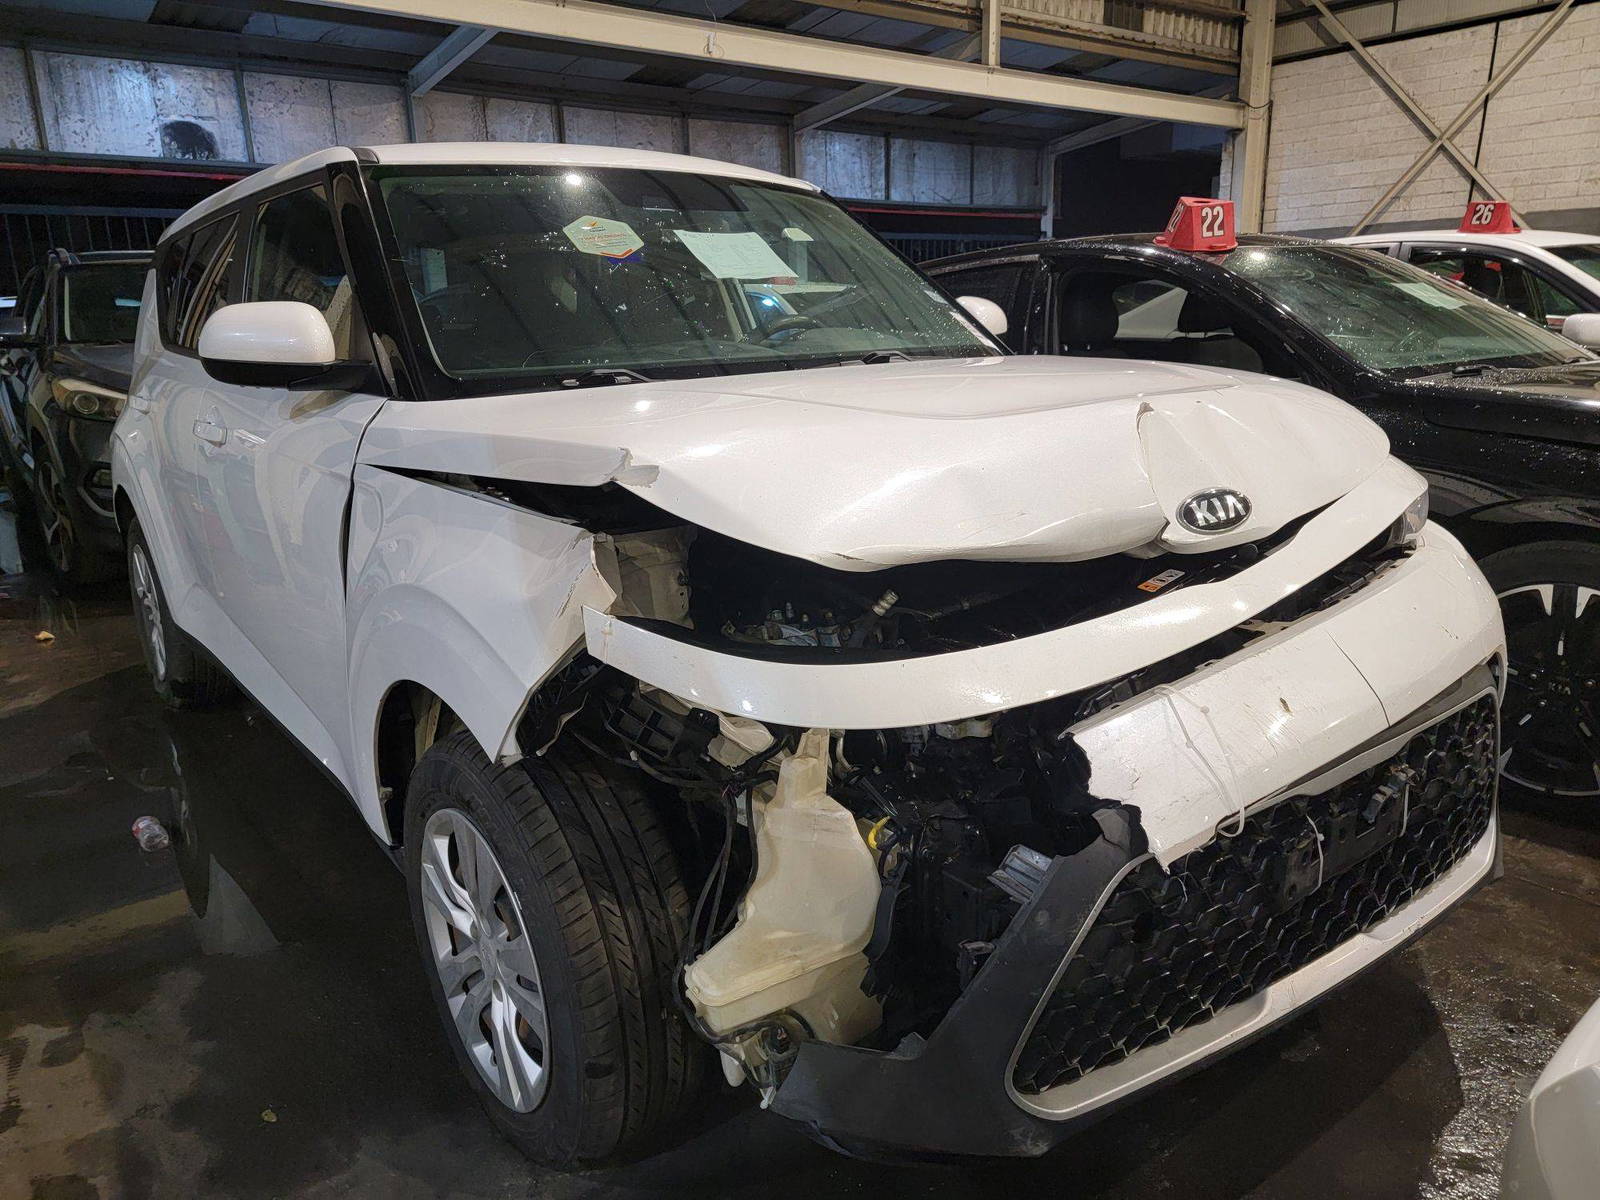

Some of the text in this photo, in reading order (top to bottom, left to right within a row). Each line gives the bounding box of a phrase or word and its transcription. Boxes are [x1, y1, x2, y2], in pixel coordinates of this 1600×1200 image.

[1201, 206, 1224, 238] 22
[1471, 204, 1495, 225] 26
[1189, 494, 1247, 527] KIA
